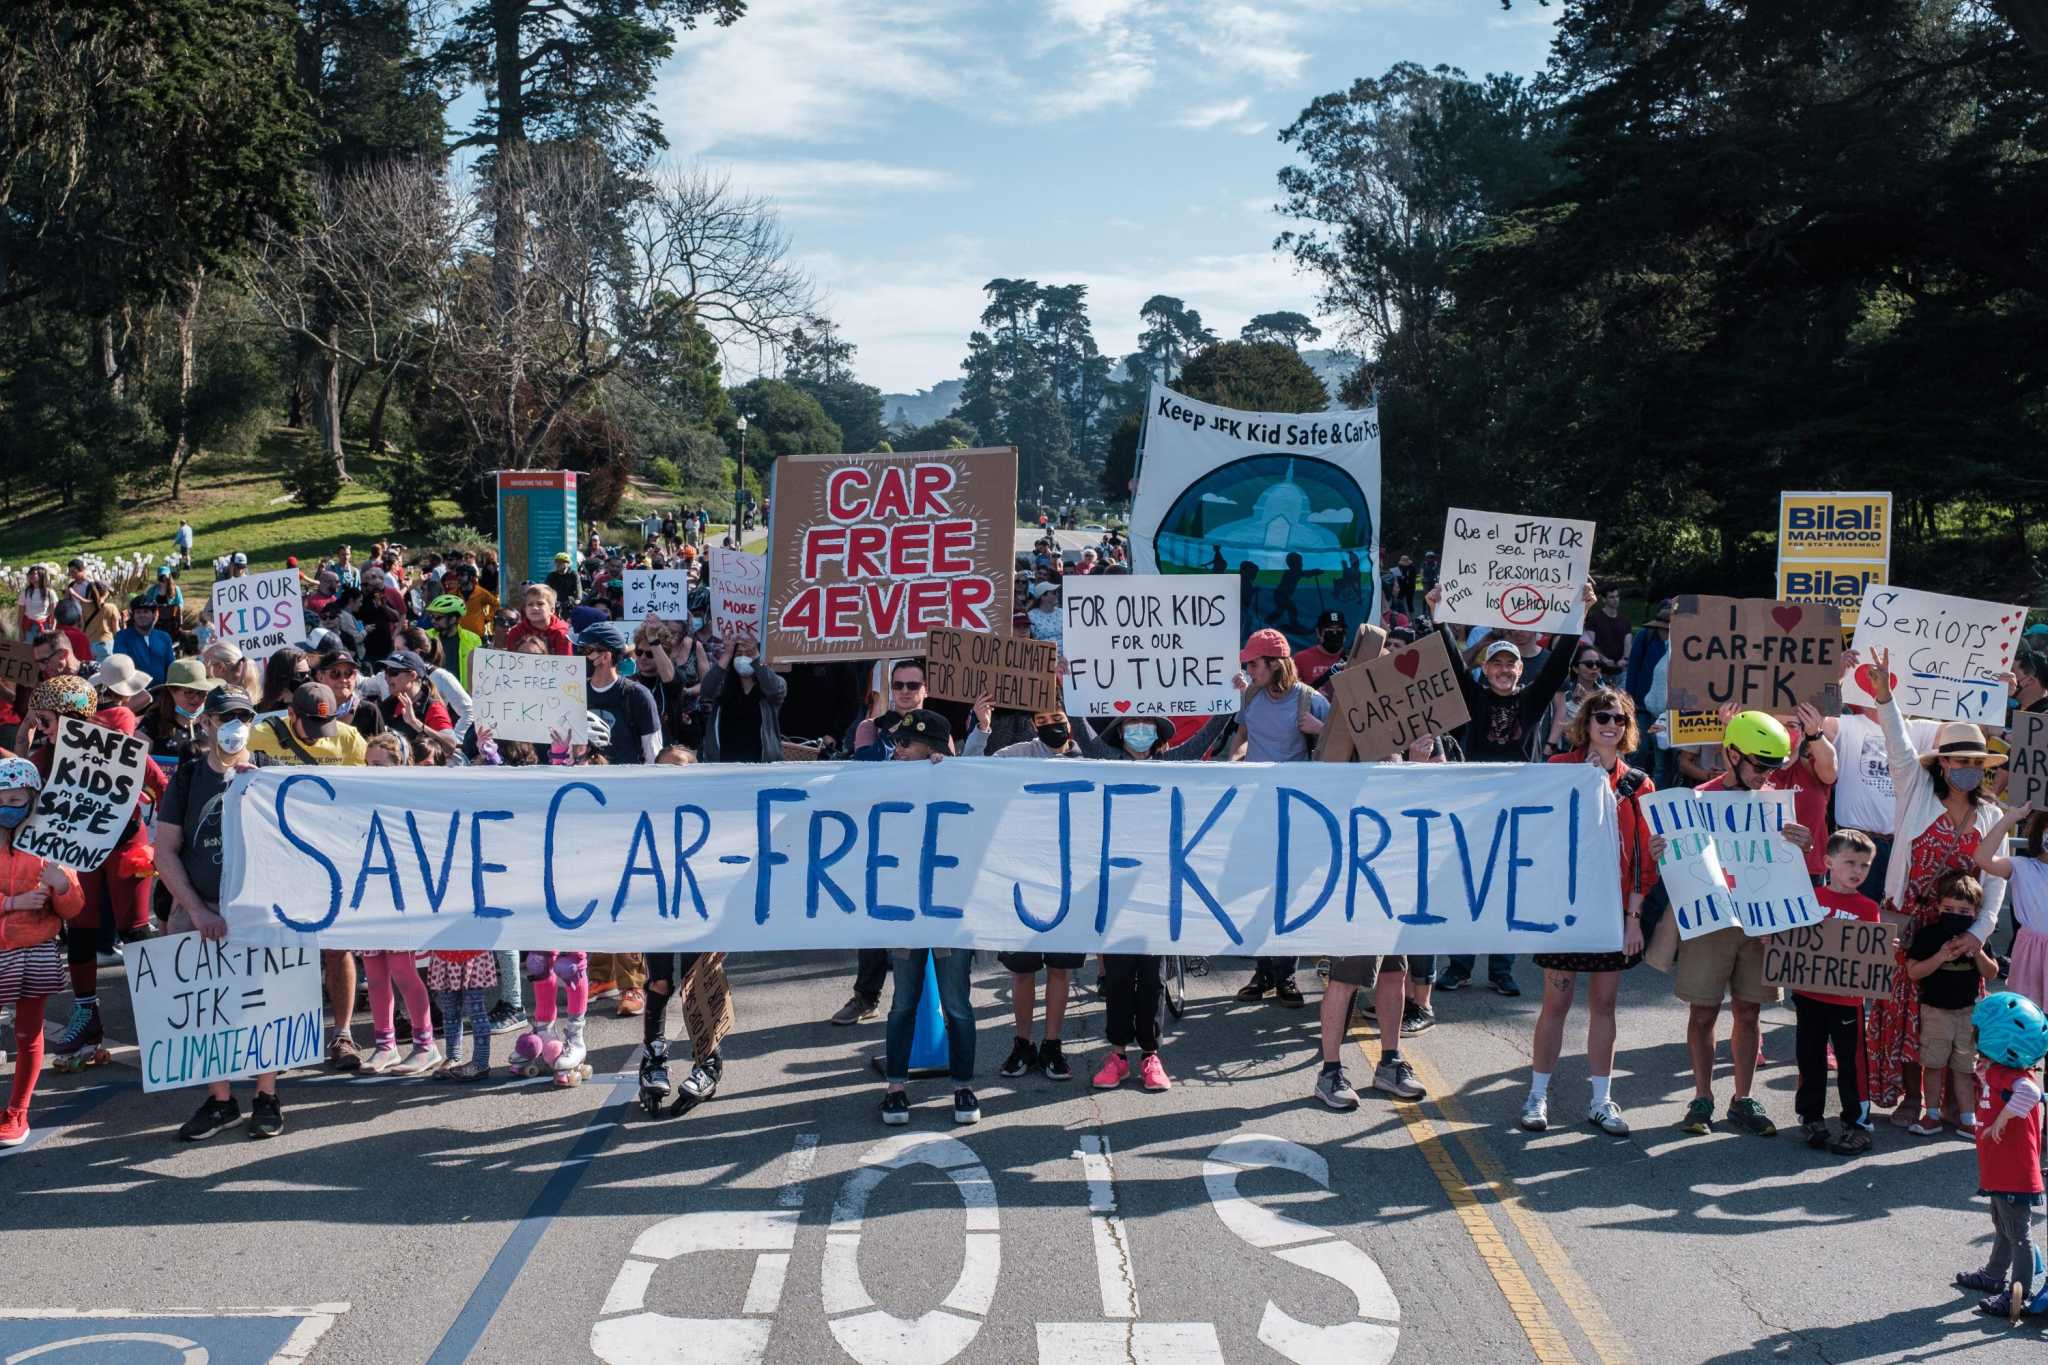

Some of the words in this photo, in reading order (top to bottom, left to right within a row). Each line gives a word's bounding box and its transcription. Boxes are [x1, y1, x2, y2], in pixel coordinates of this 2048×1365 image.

[1158, 396, 1205, 431] Keep
[1210, 416, 1242, 439] JFK
[1248, 423, 1281, 445] Kid
[1286, 423, 1328, 445] Safe
[1331, 427, 1343, 444] &
[827, 463, 955, 523] CAR
[1454, 517, 1480, 540] Que
[1487, 524, 1499, 540] el
[1515, 521, 1552, 544] JFK
[1559, 527, 1583, 548] DR
[1789, 505, 1872, 530] Bilal
[802, 519, 976, 582] FREE
[1496, 544, 1526, 555] sea
[1788, 531, 1882, 541] MAHMOOD
[712, 551, 760, 580] LESS
[217, 584, 248, 605] FOR
[257, 577, 297, 600] OUR
[648, 574, 680, 595] Young
[711, 577, 764, 597] PARKING
[1443, 578, 1459, 592] no
[1446, 586, 1472, 612] para
[1786, 571, 1870, 596] Bilal
[723, 600, 757, 614] MORE
[780, 576, 994, 641] 4EVER
[1068, 595, 1107, 628] FOR
[1116, 596, 1163, 628] OUR
[1173, 595, 1225, 627] KIDS
[1486, 592, 1500, 609] los
[219, 601, 292, 637] KIDS
[717, 617, 759, 634] PARK
[1729, 605, 1737, 631] I
[1864, 592, 1998, 649] Seniors
[239, 636, 260, 651] FOR
[263, 632, 286, 647] OUR
[930, 630, 961, 661] FOR
[972, 635, 1000, 666] OUR
[1005, 640, 1056, 674] CLIMATE
[1112, 635, 1144, 649] FOR
[1151, 634, 1183, 650] OUR
[1682, 634, 1835, 665] CAR-FREE
[484, 654, 526, 671] KIDS
[534, 659, 560, 672] FOR
[1070, 657, 1224, 690] FUTURE
[1908, 647, 1949, 674] Car
[1963, 652, 2000, 681] Free
[927, 661, 955, 697] FOR
[962, 666, 989, 698] OUR
[994, 672, 1050, 708] HEALTH
[1366, 668, 1377, 693] I
[1707, 664, 1798, 708] JFK
[1090, 702, 1109, 714] WE
[1137, 702, 1165, 713] CAR
[1170, 701, 1197, 712] FREE
[1208, 700, 1232, 712] JFK
[1348, 669, 1455, 734] CAR-FREE
[1906, 685, 1989, 719] JFK!
[1392, 706, 1442, 746] JFK
[62, 719, 143, 768] SAFE
[80, 753, 109, 766] for
[54, 757, 133, 805] KIDS
[37, 791, 118, 834] SAFE
[48, 818, 78, 834] for
[16, 825, 113, 870] EVERYONE
[273, 774, 514, 933] SAVE
[544, 781, 975, 930] CAR-FREE
[1014, 780, 1245, 946] JFK
[1275, 786, 1579, 935] DRIVE!
[1771, 924, 1823, 951] KIDS
[1841, 926, 1887, 955] FOR
[136, 947, 157, 993] A
[1765, 948, 1860, 988] CAR-FREE
[1861, 963, 1893, 993] JFK
[168, 987, 231, 1030] JFK
[241, 989, 266, 1010] =
